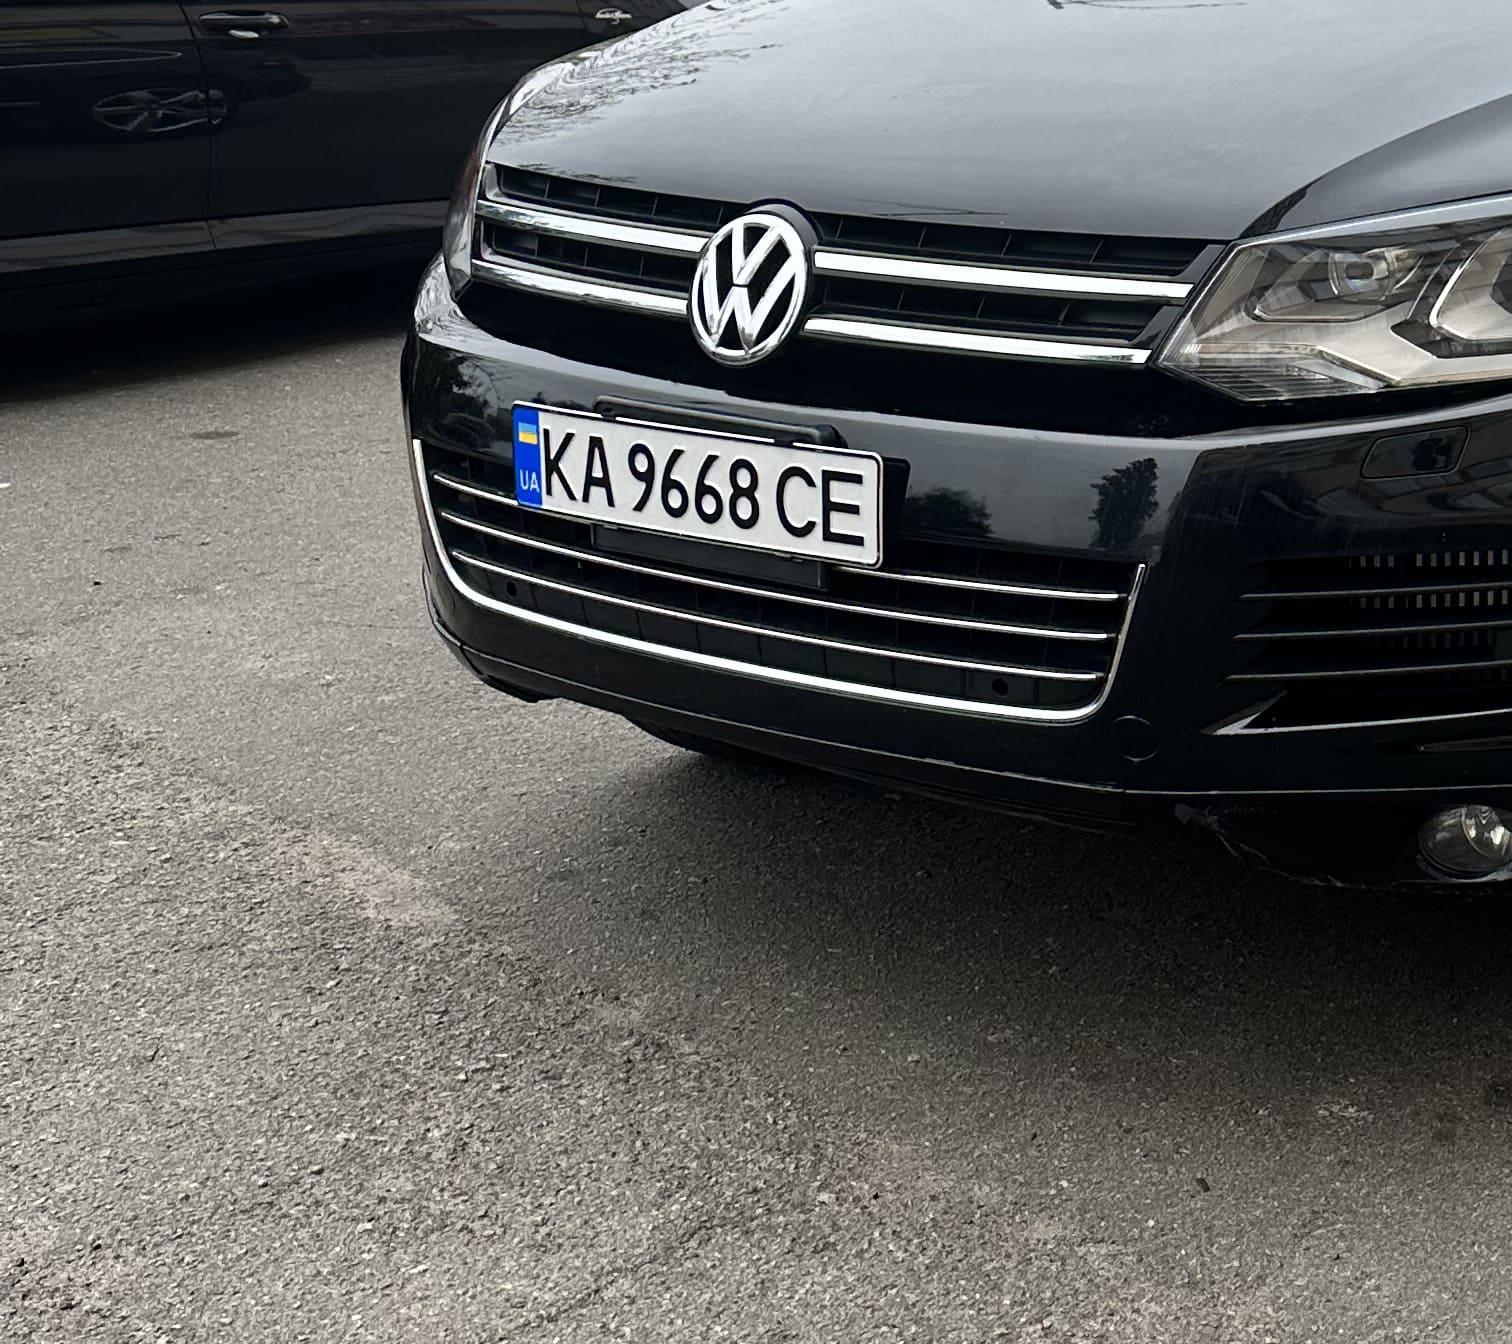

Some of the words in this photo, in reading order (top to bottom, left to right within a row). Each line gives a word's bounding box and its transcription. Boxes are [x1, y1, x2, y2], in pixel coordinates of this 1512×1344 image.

[694, 215, 807, 360] VW
[519, 469, 541, 493] UA
[543, 427, 616, 508] KA
[627, 442, 760, 530] 9668
[775, 465, 865, 548] CE
